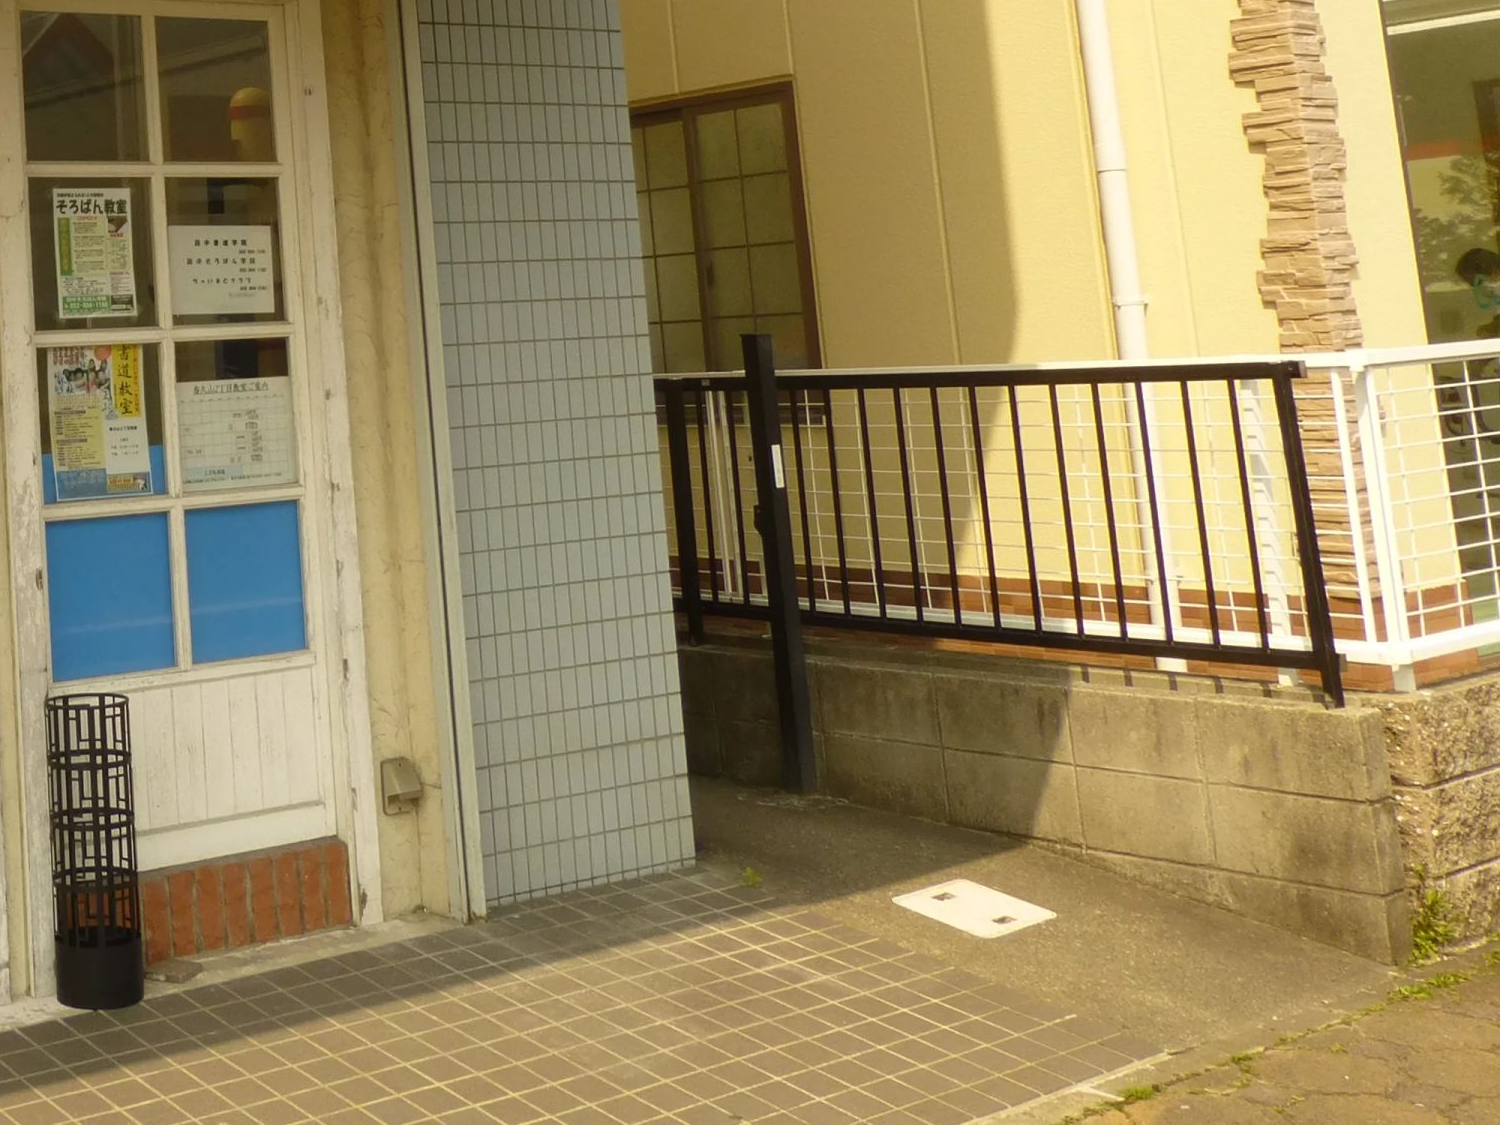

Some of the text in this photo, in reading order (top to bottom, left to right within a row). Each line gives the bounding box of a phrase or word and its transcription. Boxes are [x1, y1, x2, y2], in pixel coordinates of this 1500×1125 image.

[56, 198, 128, 215] そろばん教室
